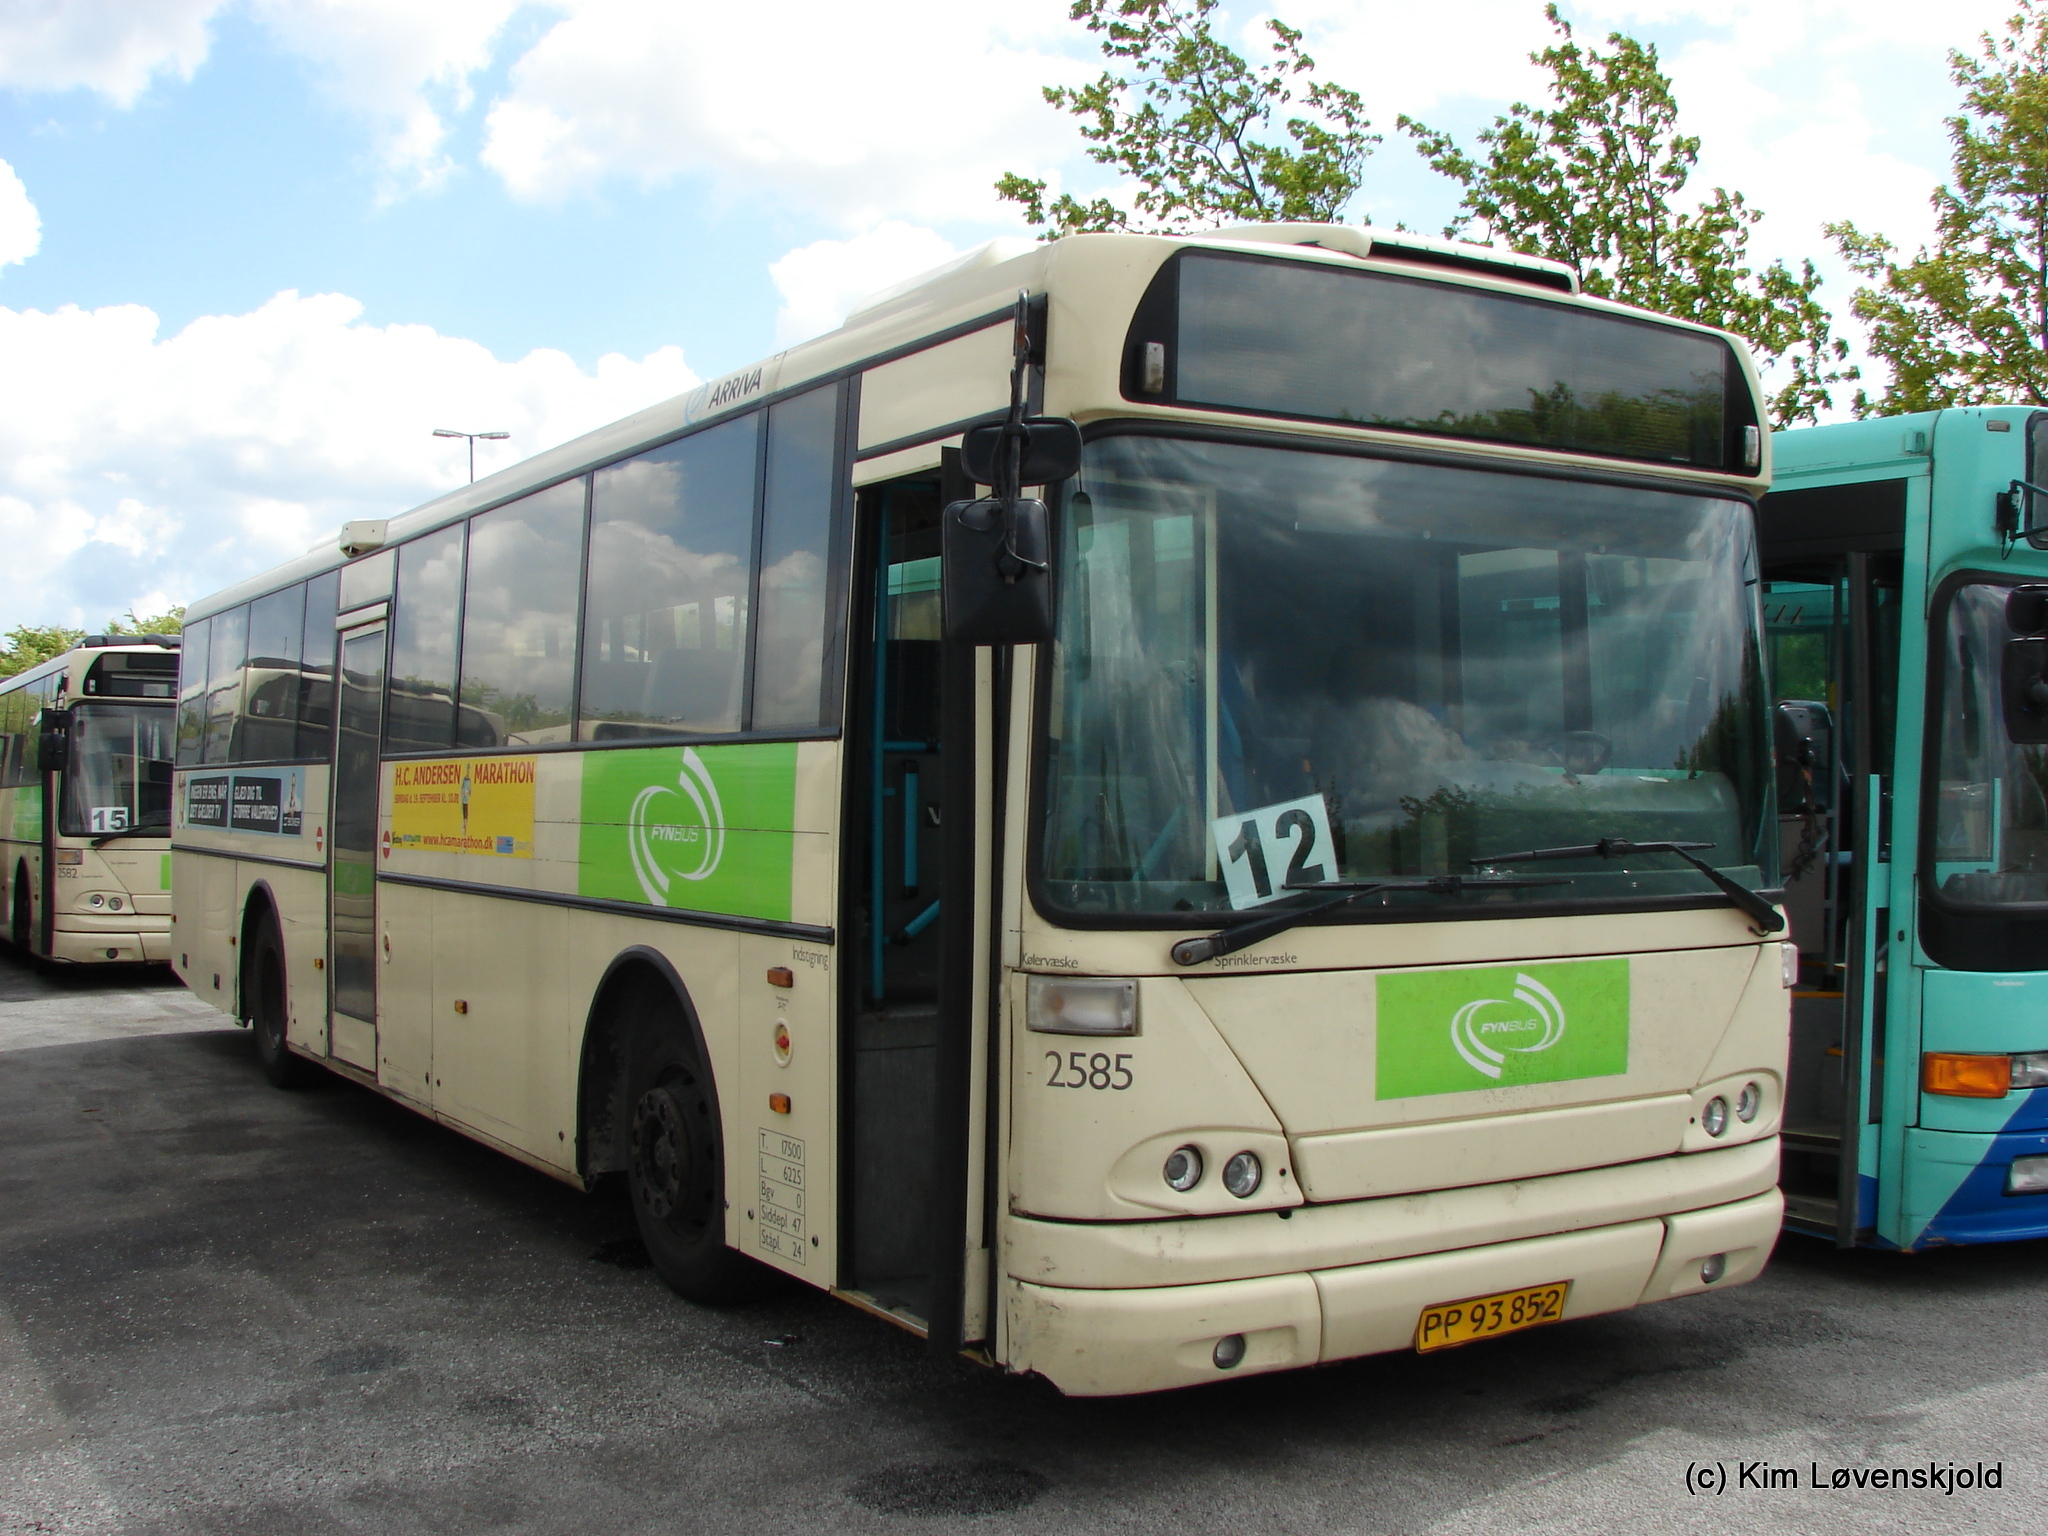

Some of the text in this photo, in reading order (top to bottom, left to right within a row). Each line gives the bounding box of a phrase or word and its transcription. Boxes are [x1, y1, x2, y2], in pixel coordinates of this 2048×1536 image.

[708, 367, 763, 410] ARRIVA
[395, 761, 535, 786] H.C. ANDERSEN MARATHON
[419, 793, 441, 804] SEPTEMBER
[93, 810, 127, 831] 15
[423, 833, 494, 851] www.hcamarathon.dk
[651, 824, 700, 843] FYNBUS
[1228, 809, 1325, 899] 12
[792, 944, 829, 971] Indstigning
[1022, 952, 1079, 969] Kølervæske
[1214, 953, 1298, 968] Sprinklervæske
[1480, 1018, 1538, 1034] FYNBUS
[1045, 1050, 1134, 1090] 2585
[781, 1139, 802, 1161] 17500
[783, 1165, 802, 1186] 6225
[761, 1180, 775, 1202] Bgv
[792, 1216, 802, 1234] 47
[792, 1241, 802, 1260] 24
[1424, 1289, 1560, 1343] PP 93 852
